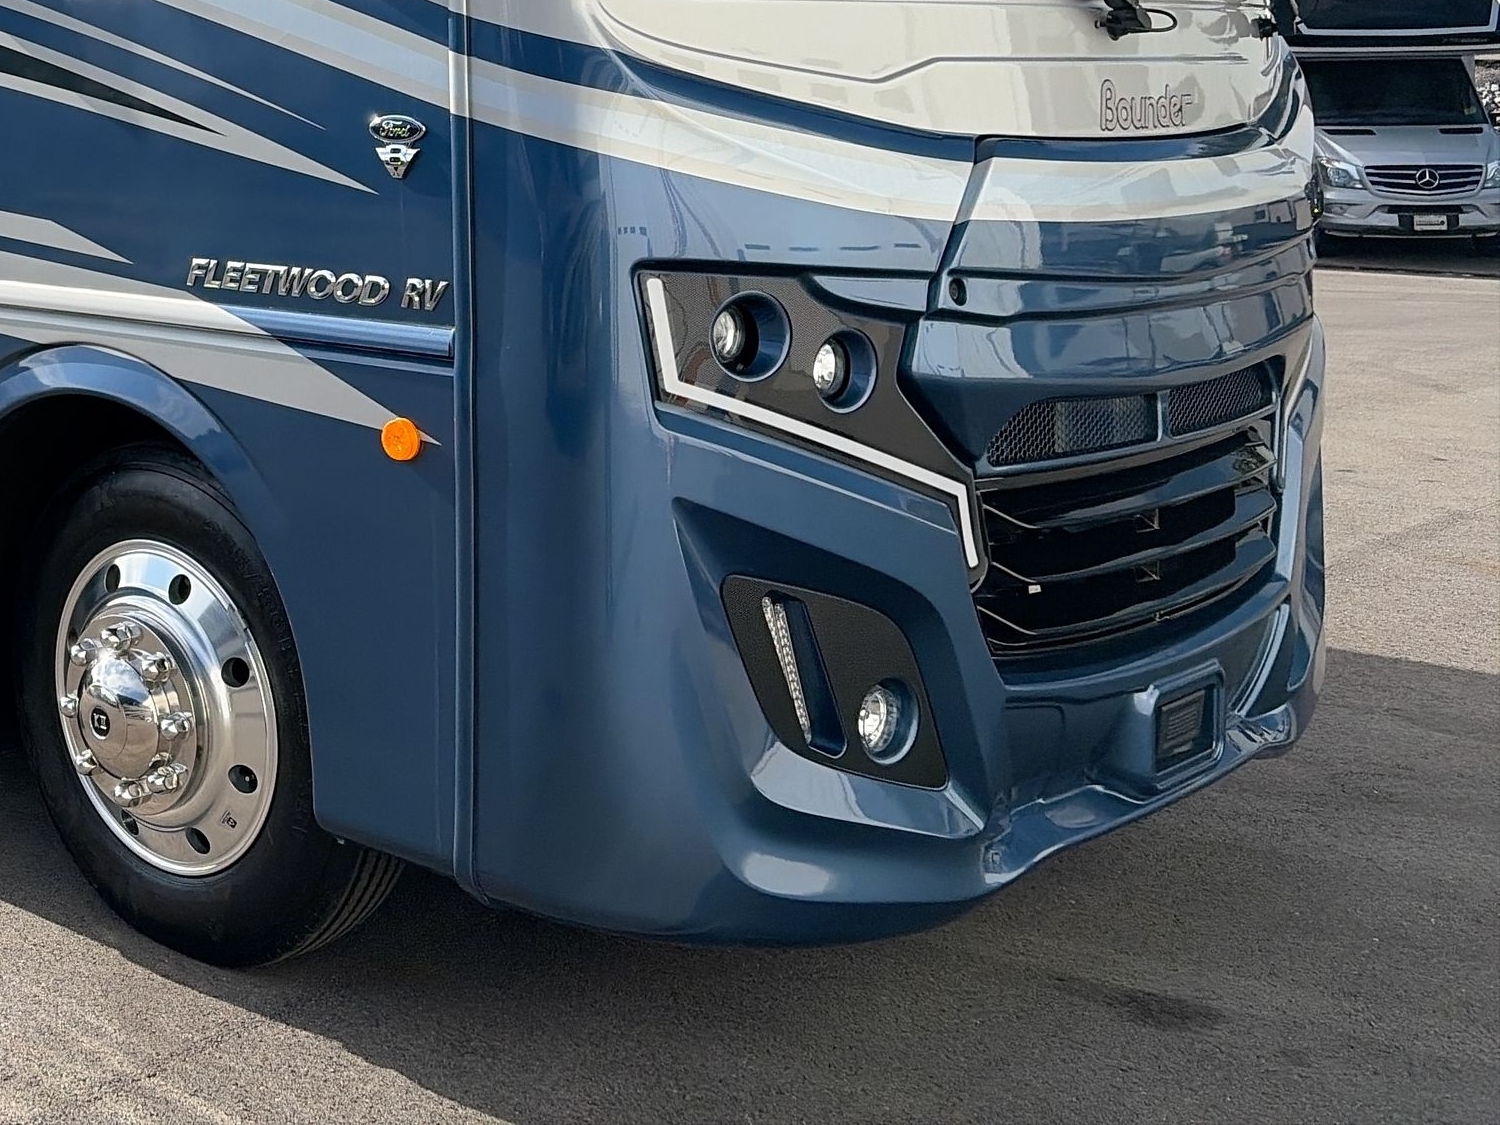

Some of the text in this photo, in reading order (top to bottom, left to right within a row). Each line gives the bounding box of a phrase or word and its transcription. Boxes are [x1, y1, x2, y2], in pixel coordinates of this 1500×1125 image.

[379, 120, 411, 137] Ford
[1100, 78, 1194, 131] Bounder
[186, 258, 449, 311] FLEETWOOD RV
